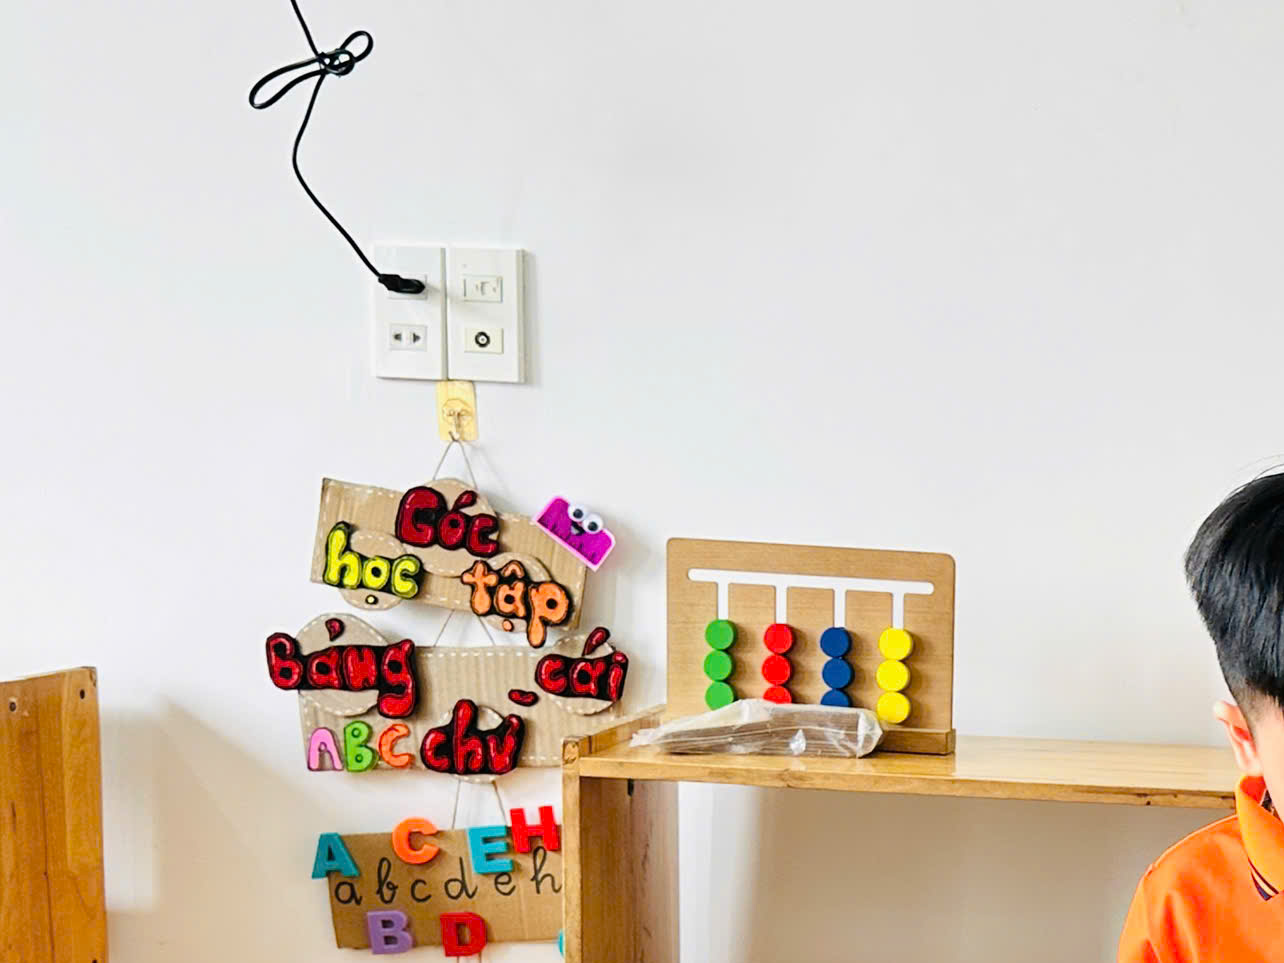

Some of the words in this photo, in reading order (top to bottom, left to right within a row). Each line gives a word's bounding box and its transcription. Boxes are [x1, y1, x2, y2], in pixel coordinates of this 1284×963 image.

[322, 521, 424, 605] học
[461, 559, 573, 648] tập
[535, 626, 629, 702] cái
